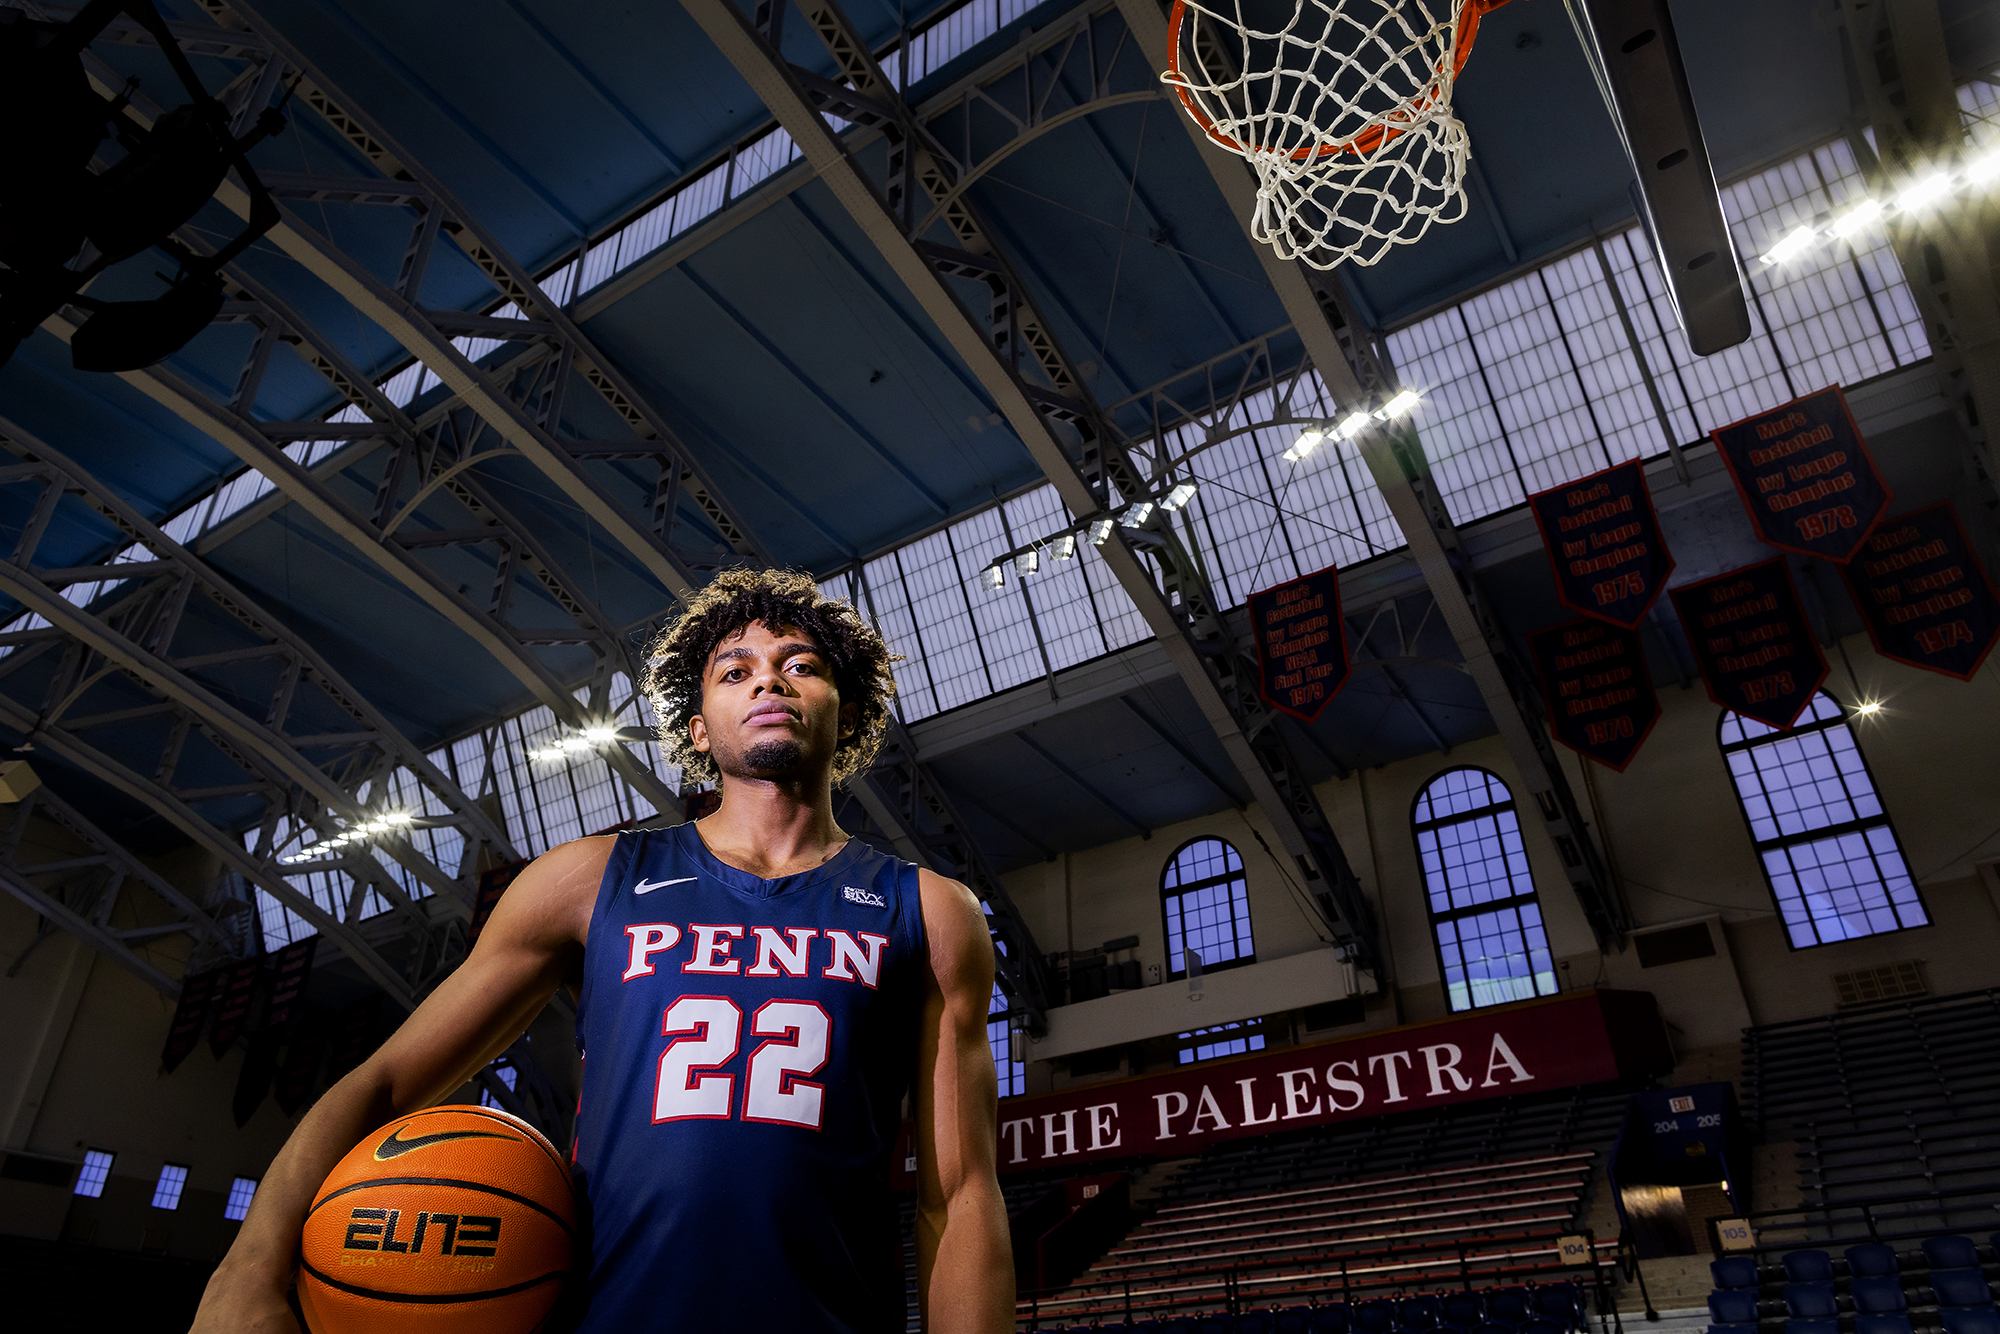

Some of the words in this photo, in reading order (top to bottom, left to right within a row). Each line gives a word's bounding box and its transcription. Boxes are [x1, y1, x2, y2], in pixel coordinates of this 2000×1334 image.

[1755, 412, 1806, 440] Men's
[1749, 423, 1833, 467] Basketball
[1757, 471, 1785, 493] Ivy
[1787, 451, 1846, 481] League
[1566, 483, 1610, 507] Men's
[1768, 471, 1856, 512] Champions
[1559, 494, 1633, 532] Basketball
[1795, 505, 1857, 541] 1978
[1562, 540, 1587, 559] Ivy
[1590, 522, 1641, 549] League
[1871, 526, 1920, 552] Men's
[1570, 542, 1647, 577] Champions
[1864, 539, 1948, 578] Basketball
[1275, 584, 1310, 606] Men's
[1592, 570, 1645, 606] 1975
[1708, 579, 1754, 604] Men's
[1871, 584, 1901, 604] Ivy
[1902, 566, 1964, 595] League
[1266, 593, 1324, 625] Basketball
[1701, 592, 1778, 629] Basketball
[1885, 587, 1974, 625] Champions
[1266, 628, 1285, 643] Ivy
[1288, 615, 1328, 637] League
[1269, 630, 1329, 658] Champions
[1563, 625, 1604, 647] Men's
[1707, 636, 1733, 655] Ivy
[1735, 620, 1790, 647] League
[1914, 619, 1974, 655] 1974
[1285, 649, 1318, 671] NCAA
[1554, 638, 1624, 671] Basketball
[1716, 642, 1796, 674] Champions
[1274, 670, 1302, 690] Final
[1305, 663, 1333, 681] Four
[1558, 678, 1581, 697] Ivy
[1584, 666, 1632, 689] League
[1740, 670, 1795, 704] 1973
[1289, 682, 1324, 707] 1979
[1565, 686, 1638, 717] Champions
[1584, 715, 1634, 745] 1970
[622, 922, 890, 991] PENN
[651, 995, 832, 1132] 22
[1002, 1102, 1121, 1164] THE
[1152, 1032, 1535, 1140] PALESTRA
[1673, 1098, 1692, 1111] EXIT
[1653, 1120, 1679, 1134] 204
[1696, 1114, 1721, 1128] 205
[343, 1207, 501, 1258] ELITE
[1722, 1227, 1748, 1240] 105
[1563, 1243, 1585, 1256] 104
